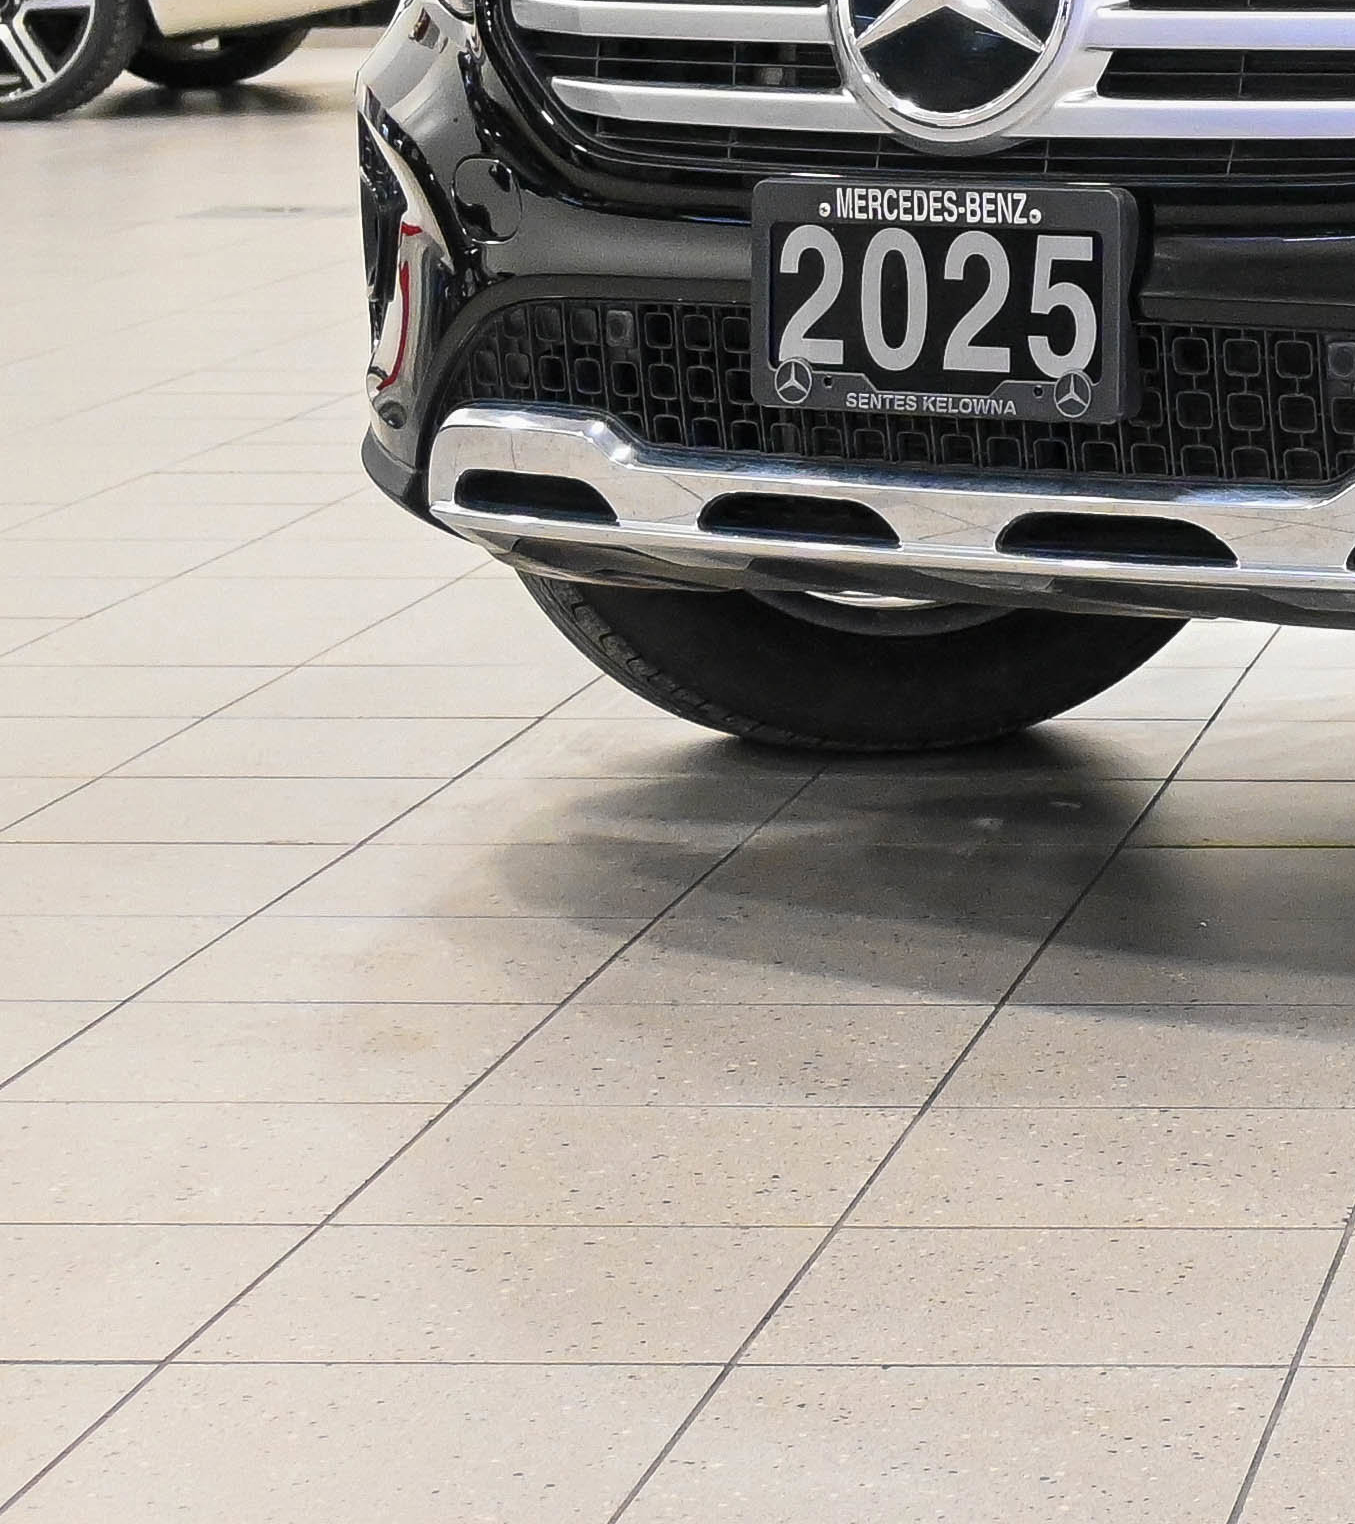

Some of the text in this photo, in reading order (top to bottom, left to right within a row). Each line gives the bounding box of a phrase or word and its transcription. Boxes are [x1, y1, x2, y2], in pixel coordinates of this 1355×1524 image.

[836, 187, 1028, 224] MERCEDES-BENZ
[779, 224, 1097, 378] 2025
[846, 392, 1017, 416] SENTES KELOWNA
